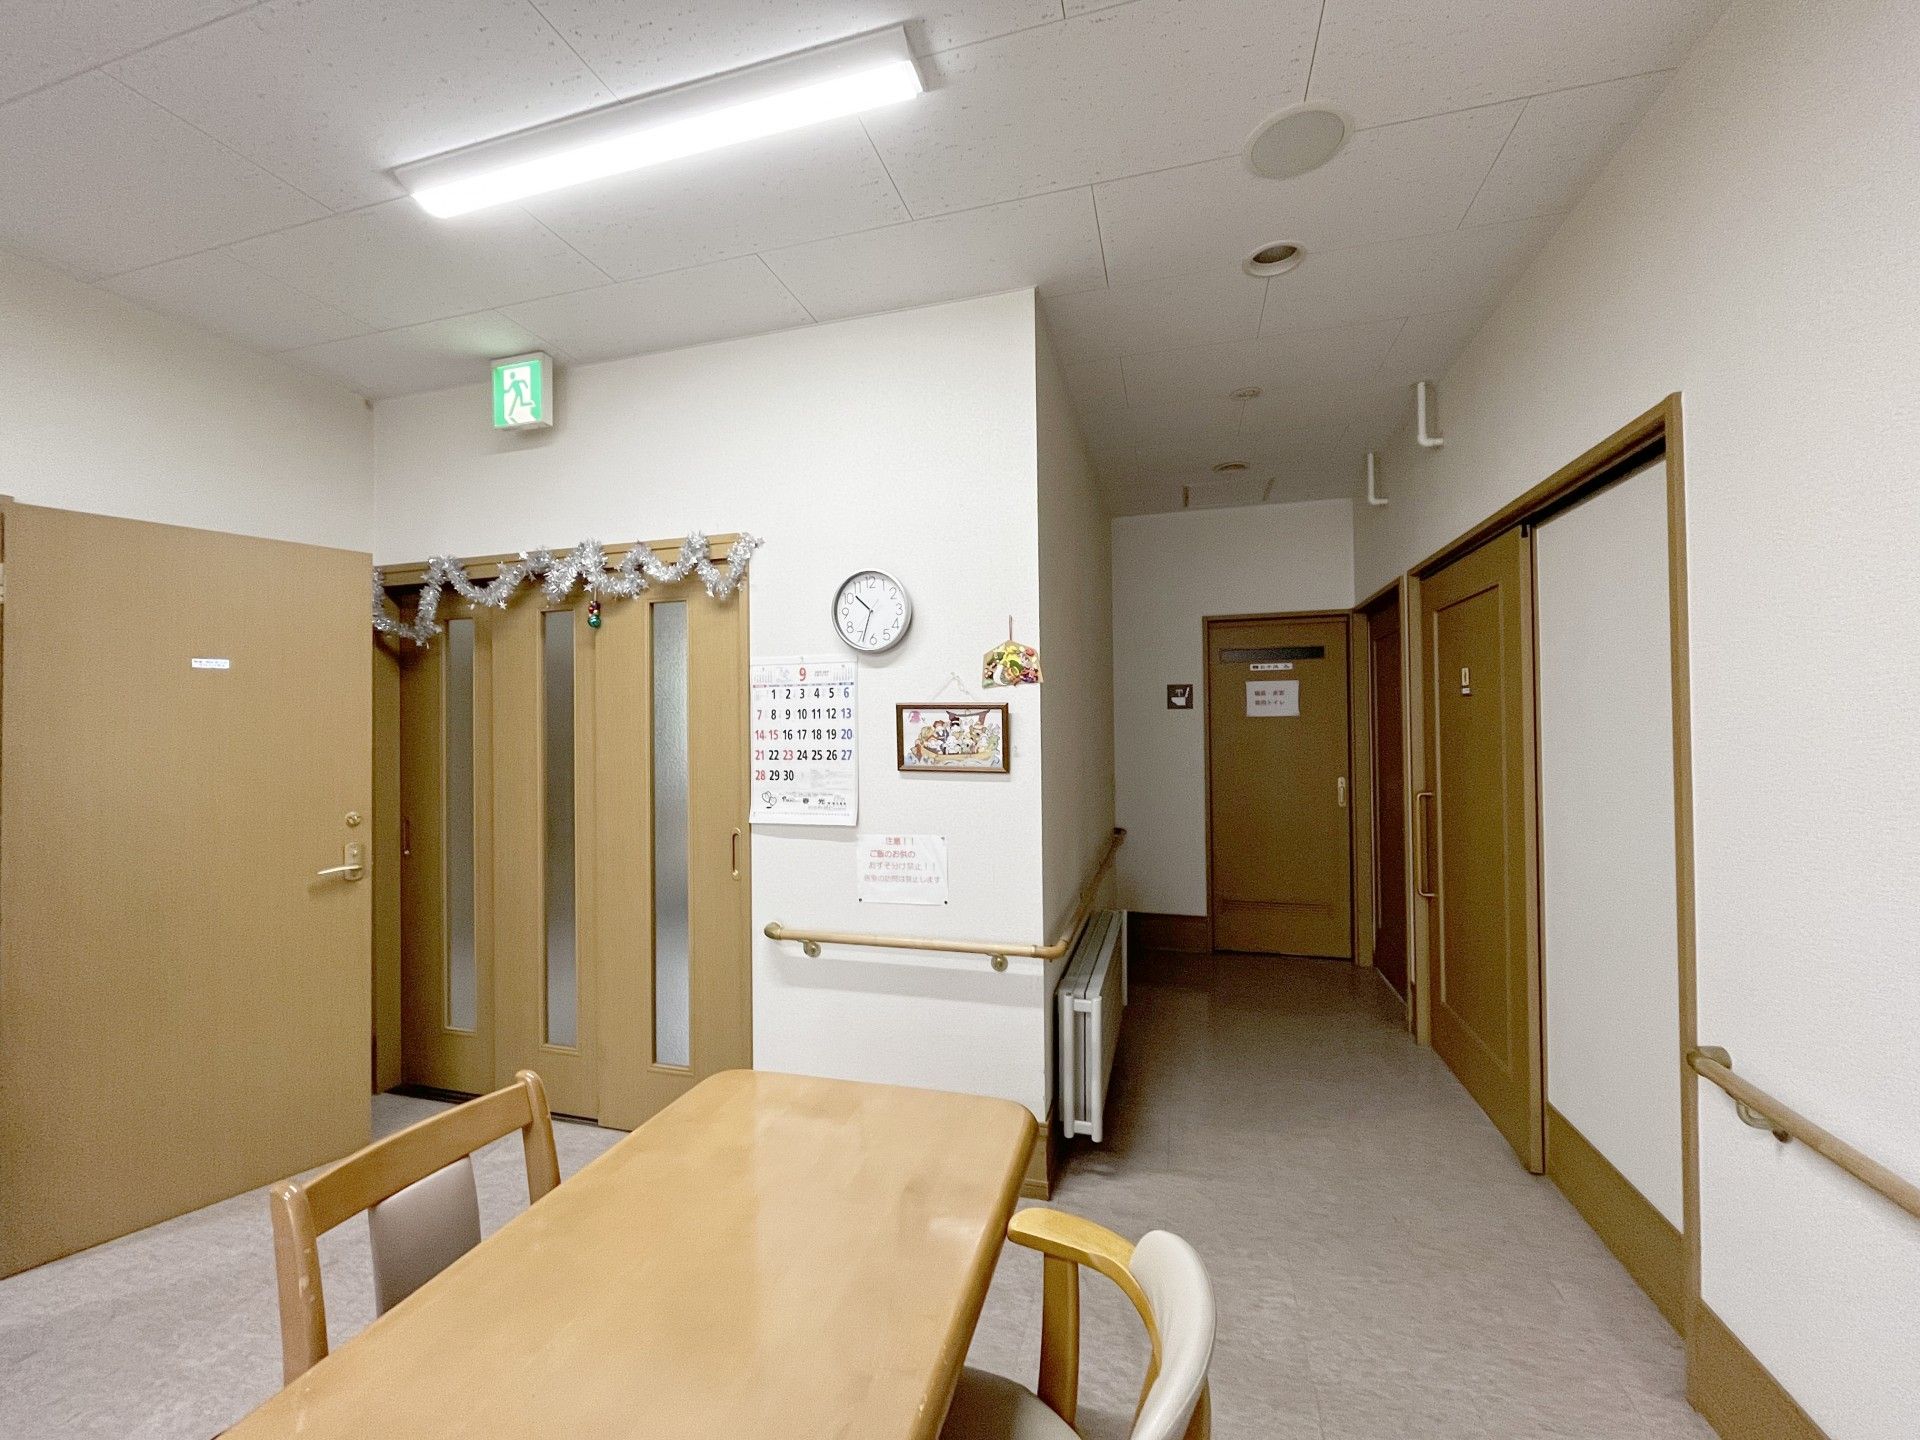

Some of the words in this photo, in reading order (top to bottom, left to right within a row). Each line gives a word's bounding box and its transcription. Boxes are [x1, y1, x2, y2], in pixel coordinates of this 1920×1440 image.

[853, 581, 862, 593] 11
[865, 576, 876, 588] 12
[882, 579, 885, 591] 1
[843, 593, 854, 604] 10
[889, 587, 897, 599] 2
[842, 607, 849, 619] 9
[896, 603, 903, 615] 3
[846, 621, 854, 633] 8
[892, 618, 899, 629] 4
[870, 634, 877, 645] 6
[883, 629, 890, 640] 5
[799, 667, 806, 681] 9
[772, 689, 775, 699] 1
[786, 689, 791, 699] 2
[800, 689, 804, 699] 3
[814, 688, 820, 698] 4
[829, 688, 834, 698] 5
[844, 687, 849, 698] 6
[757, 710, 762, 720] 7
[771, 709, 776, 720] 8
[785, 709, 790, 719] 9
[797, 709, 807, 719] 10
[812, 709, 821, 719] 11
[826, 708, 836, 719] 12
[841, 708, 851, 719] 13
[755, 730, 765, 740] 14
[769, 729, 778, 740] 15
[783, 729, 793, 740] 16
[797, 729, 807, 740] 17
[812, 729, 822, 740] 18
[826, 729, 836, 740] 19
[841, 729, 852, 740] 20
[755, 750, 764, 760] 21
[769, 750, 779, 760] 22
[783, 750, 793, 760] 23
[797, 750, 808, 760] 24
[812, 750, 823, 760] 25
[826, 749, 837, 760] 26
[841, 750, 852, 760] 27
[755, 770, 765, 781] 28
[769, 770, 780, 781] 29
[784, 770, 794, 781] 30
